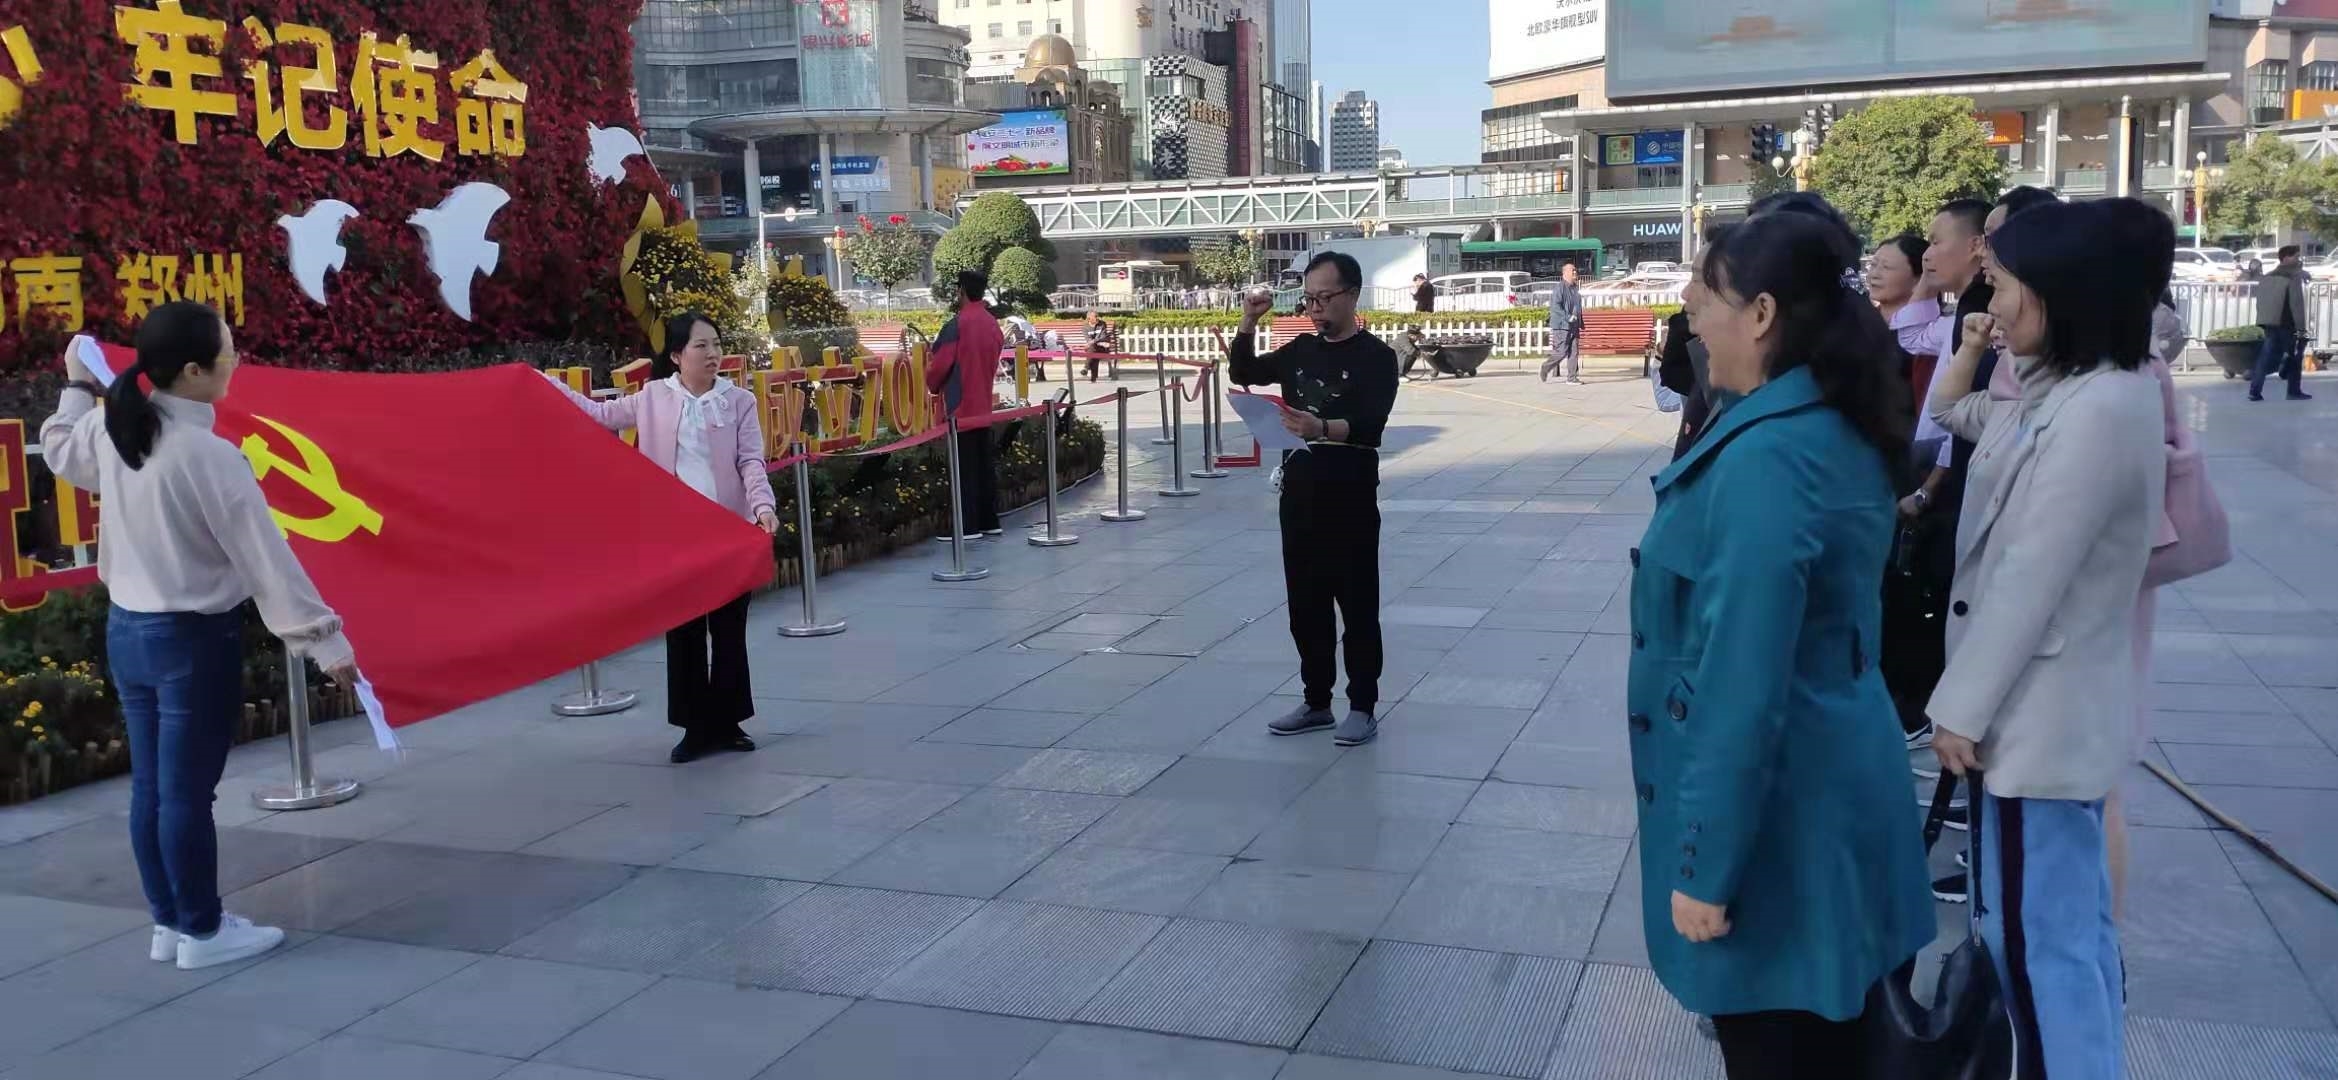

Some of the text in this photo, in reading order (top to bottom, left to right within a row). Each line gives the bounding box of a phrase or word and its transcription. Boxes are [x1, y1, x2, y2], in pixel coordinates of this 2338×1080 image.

[114, 0, 528, 162] 牢记使命
[0, 252, 244, 333] 南 郑州
